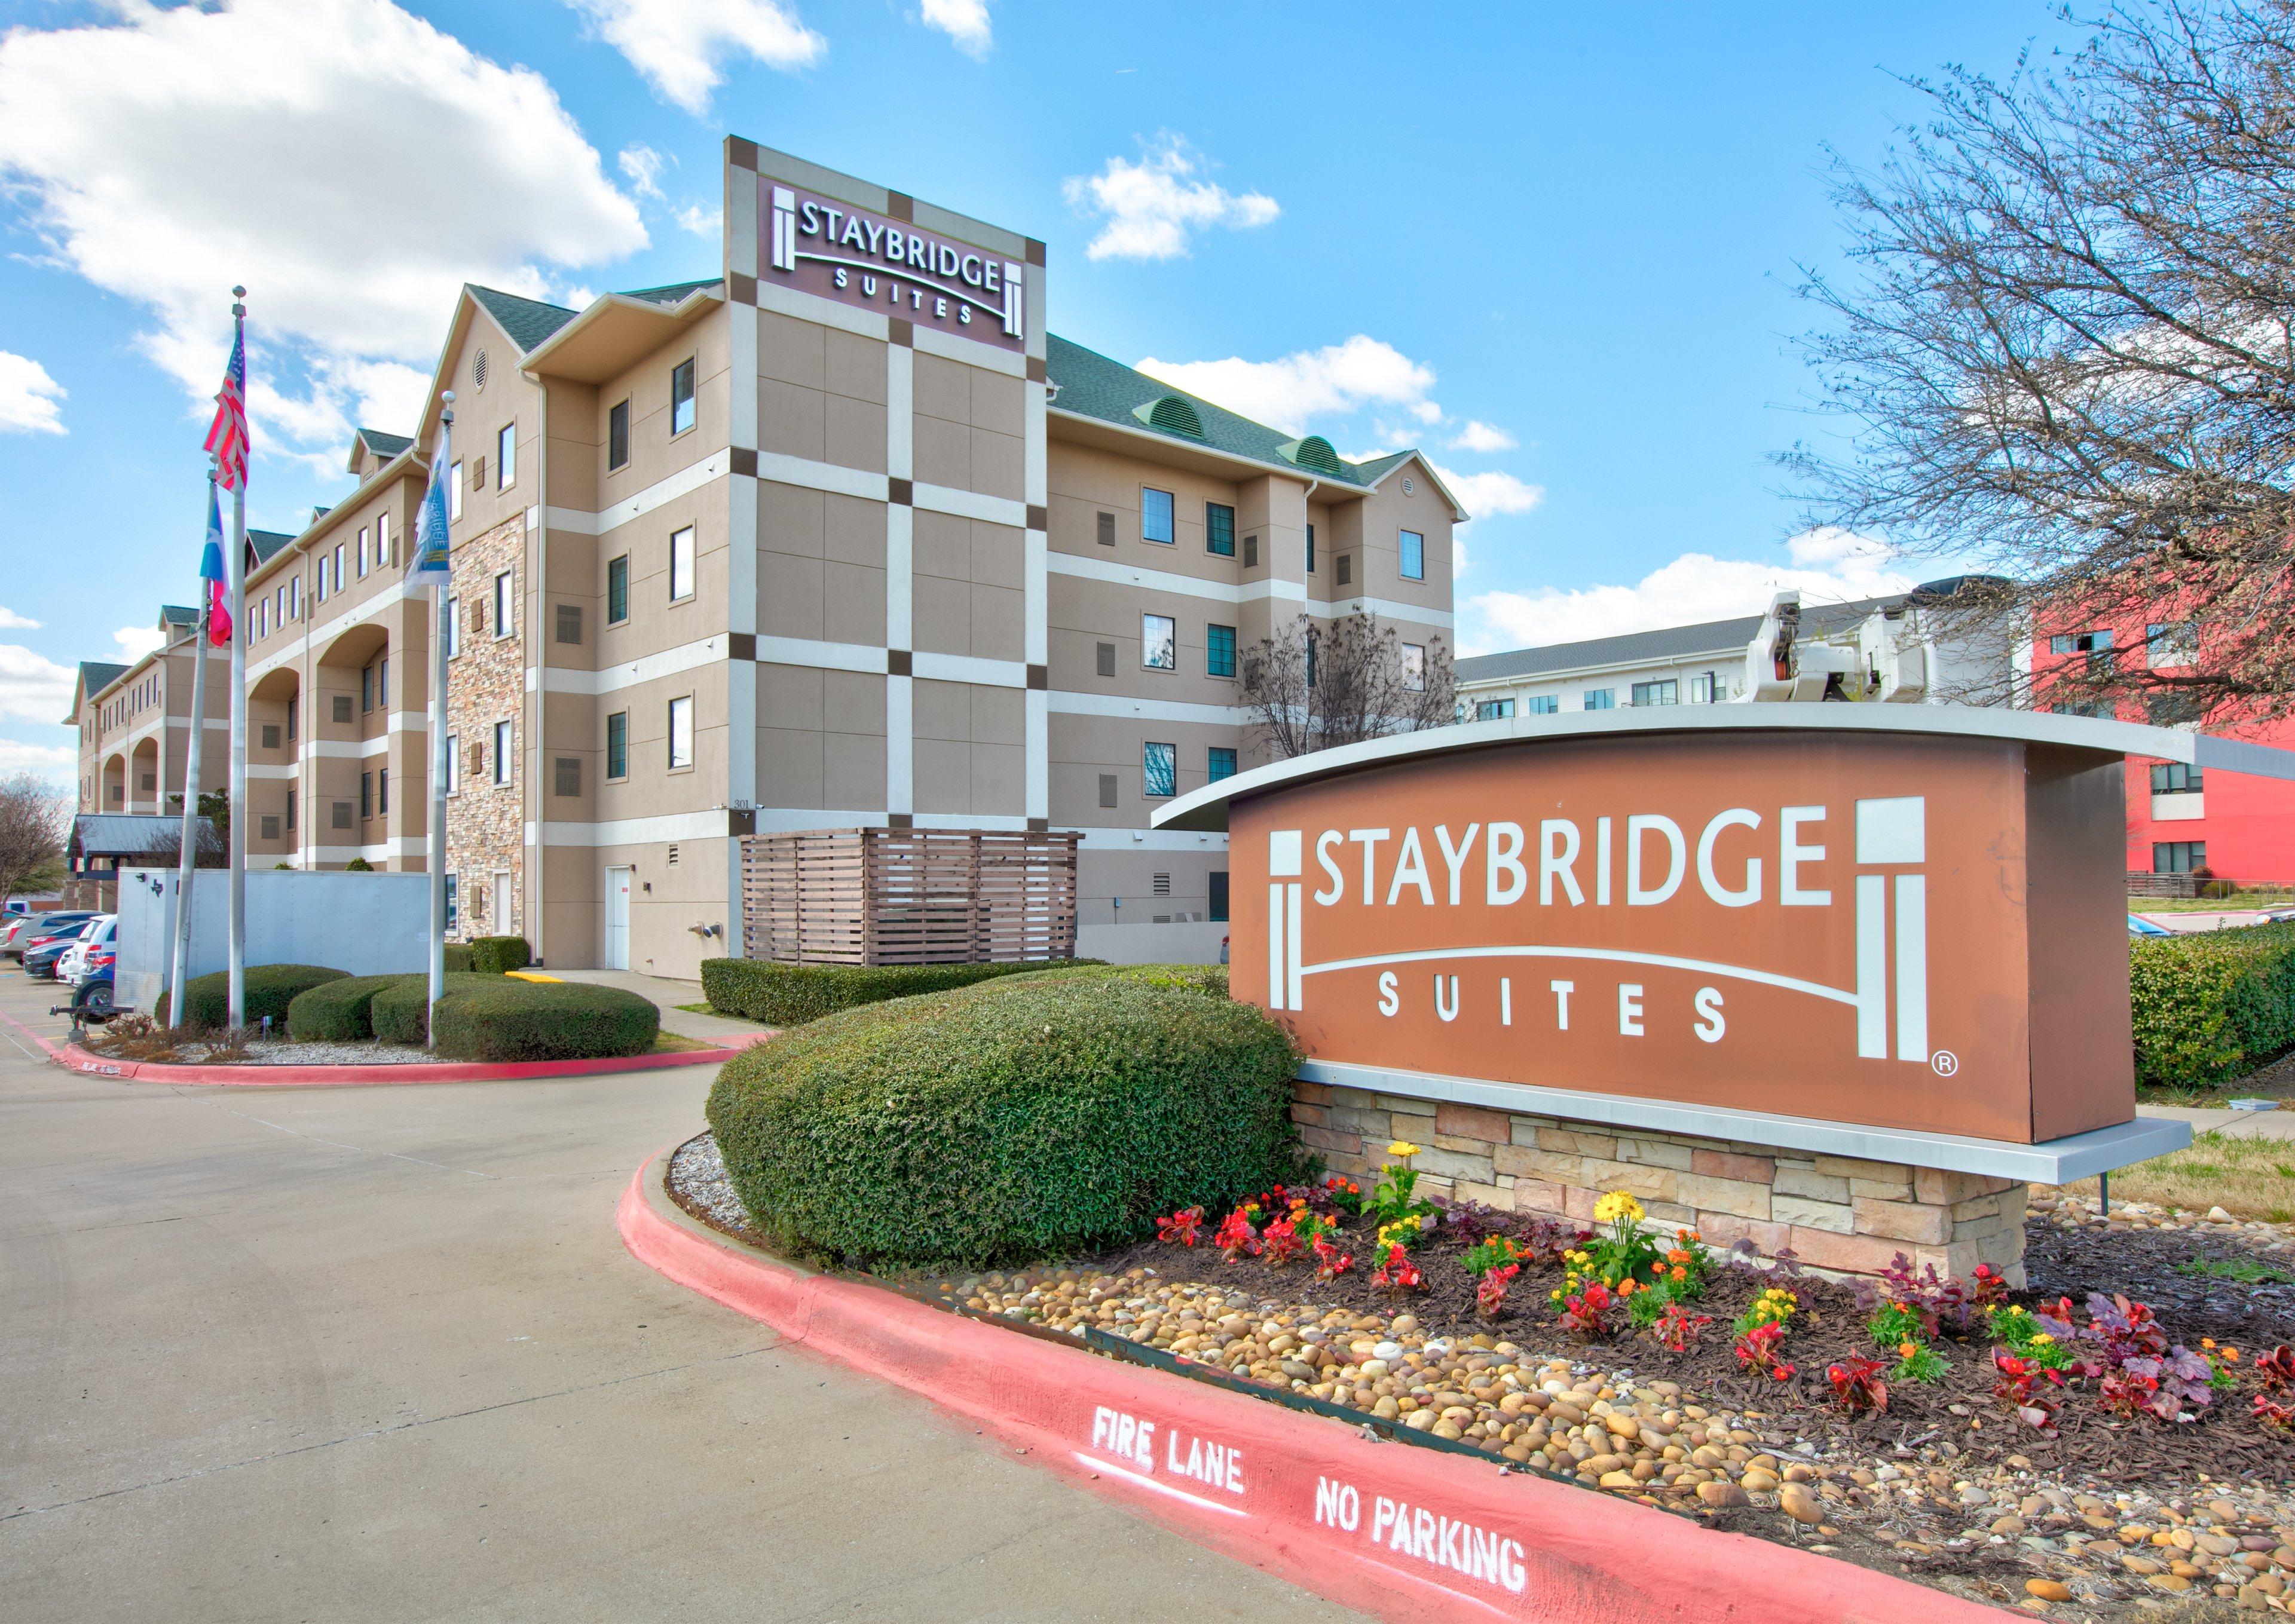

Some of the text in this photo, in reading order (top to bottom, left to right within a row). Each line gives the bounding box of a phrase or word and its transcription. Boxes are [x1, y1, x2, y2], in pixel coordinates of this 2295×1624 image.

[800, 201, 1000, 292] STAYBRIDGE
[834, 268, 971, 324] SUITES
[735, 799, 749, 809] 301
[1314, 805, 1832, 908] STAYBRIDGE
[1378, 971, 1726, 1043] SUITES
[1092, 1405, 1527, 1594] FIRE LANE NO PARKING
